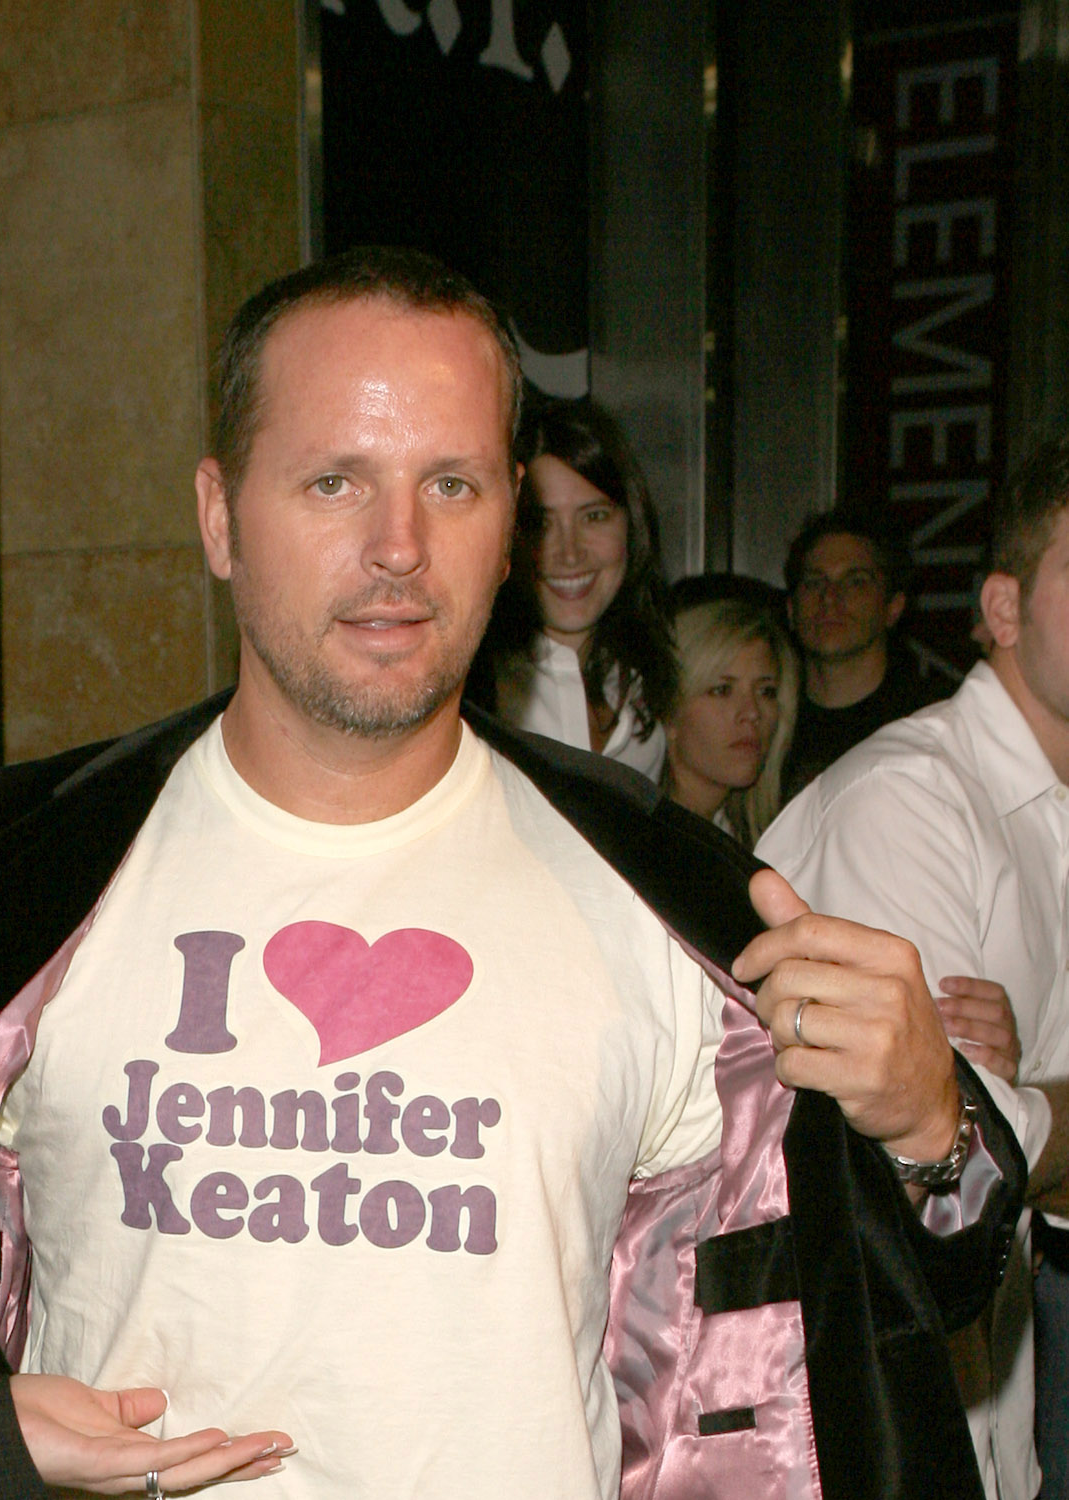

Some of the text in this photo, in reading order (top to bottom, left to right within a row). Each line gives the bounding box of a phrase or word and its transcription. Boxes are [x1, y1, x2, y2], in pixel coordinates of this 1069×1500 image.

[164, 930, 246, 1054] I
[101, 1059, 501, 1160] Jennifer
[109, 1141, 499, 1256] Keaton
